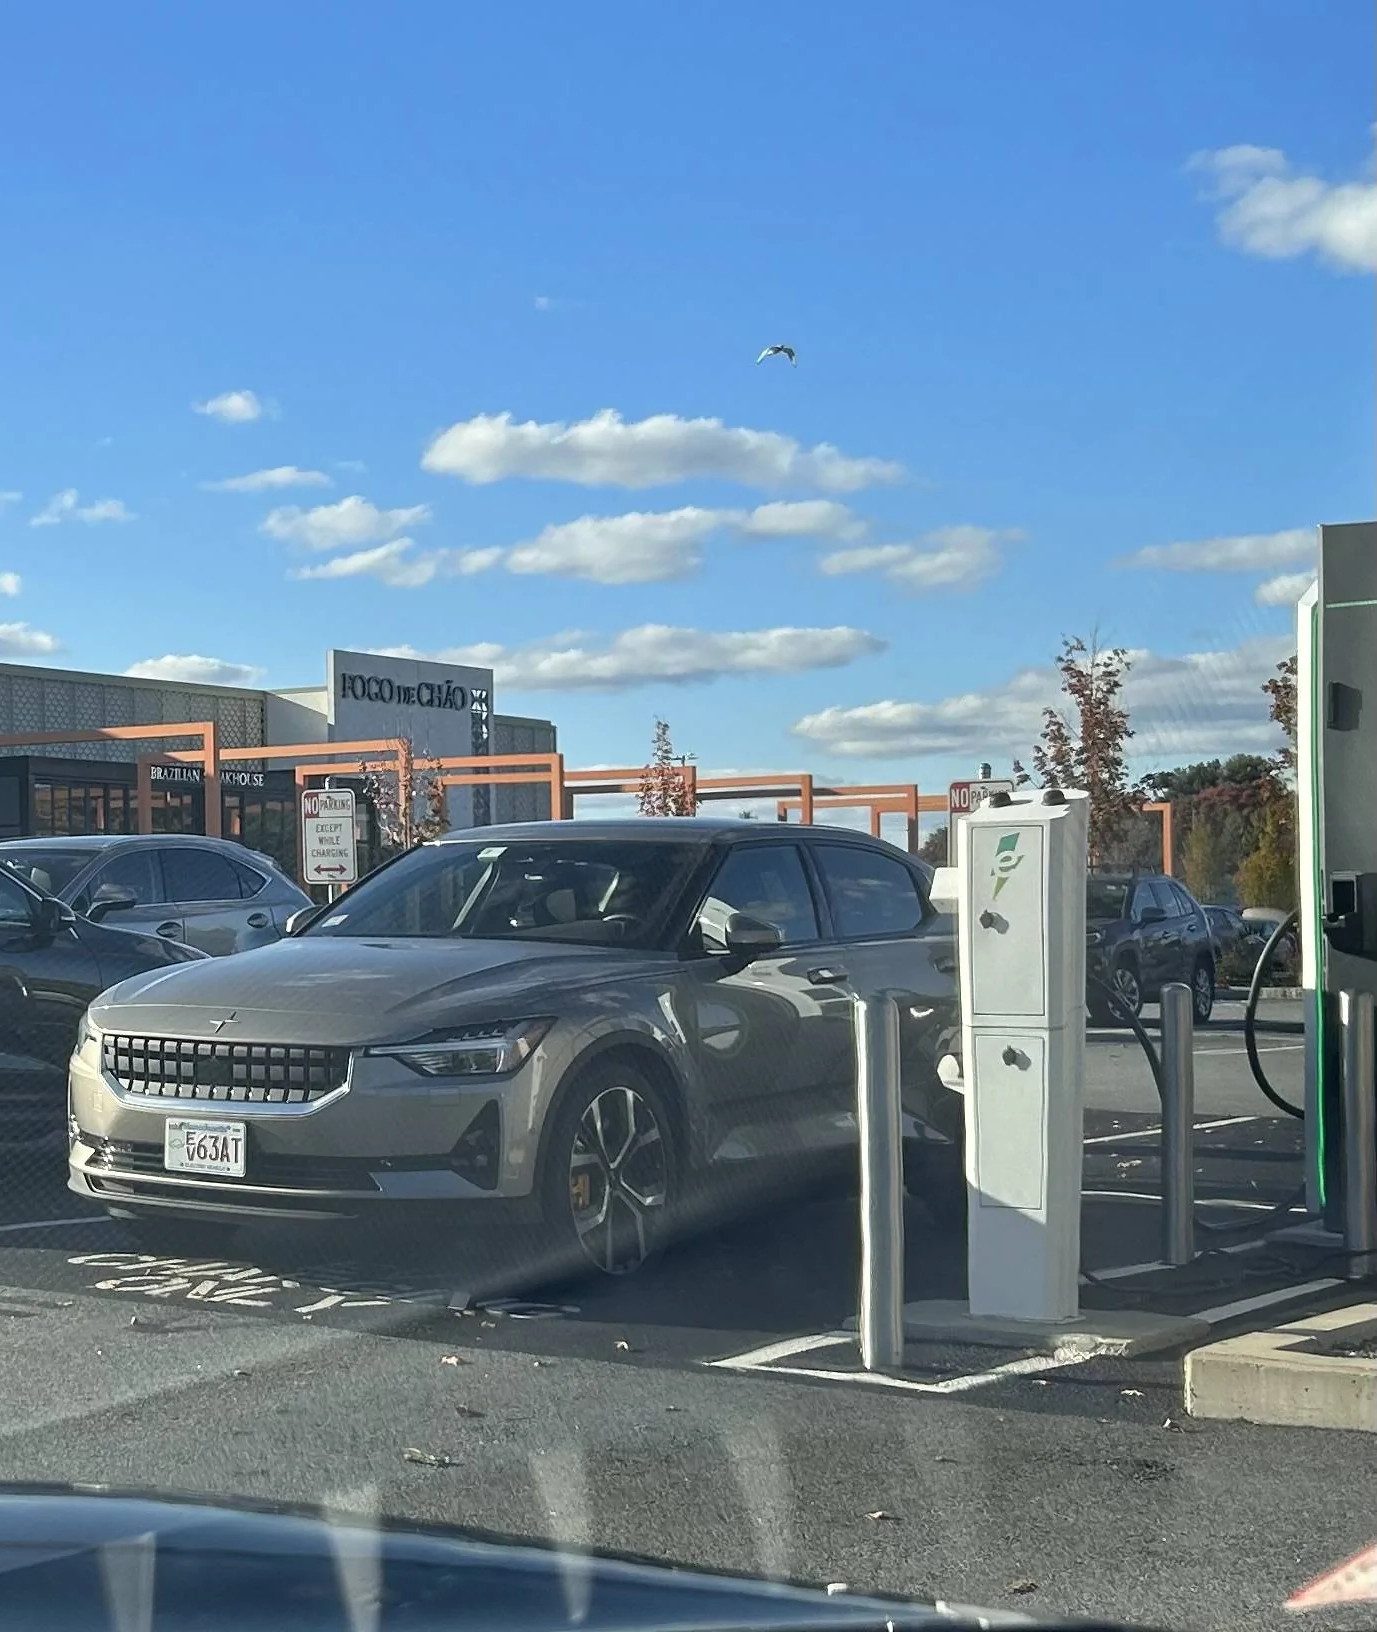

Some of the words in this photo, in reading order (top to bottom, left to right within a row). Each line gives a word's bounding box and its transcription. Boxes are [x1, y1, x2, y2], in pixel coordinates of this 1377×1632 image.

[341, 672, 394, 703] FOGO
[150, 766, 201, 783] BRAZILIAN
[220, 770, 265, 787] AKHOUSE
[304, 796, 319, 815] NO
[320, 799, 351, 811] PARKING
[951, 788, 969, 808] NO
[315, 823, 342, 833] EXCEPT
[318, 835, 341, 846] WHILE
[311, 848, 349, 858] CHARGING
